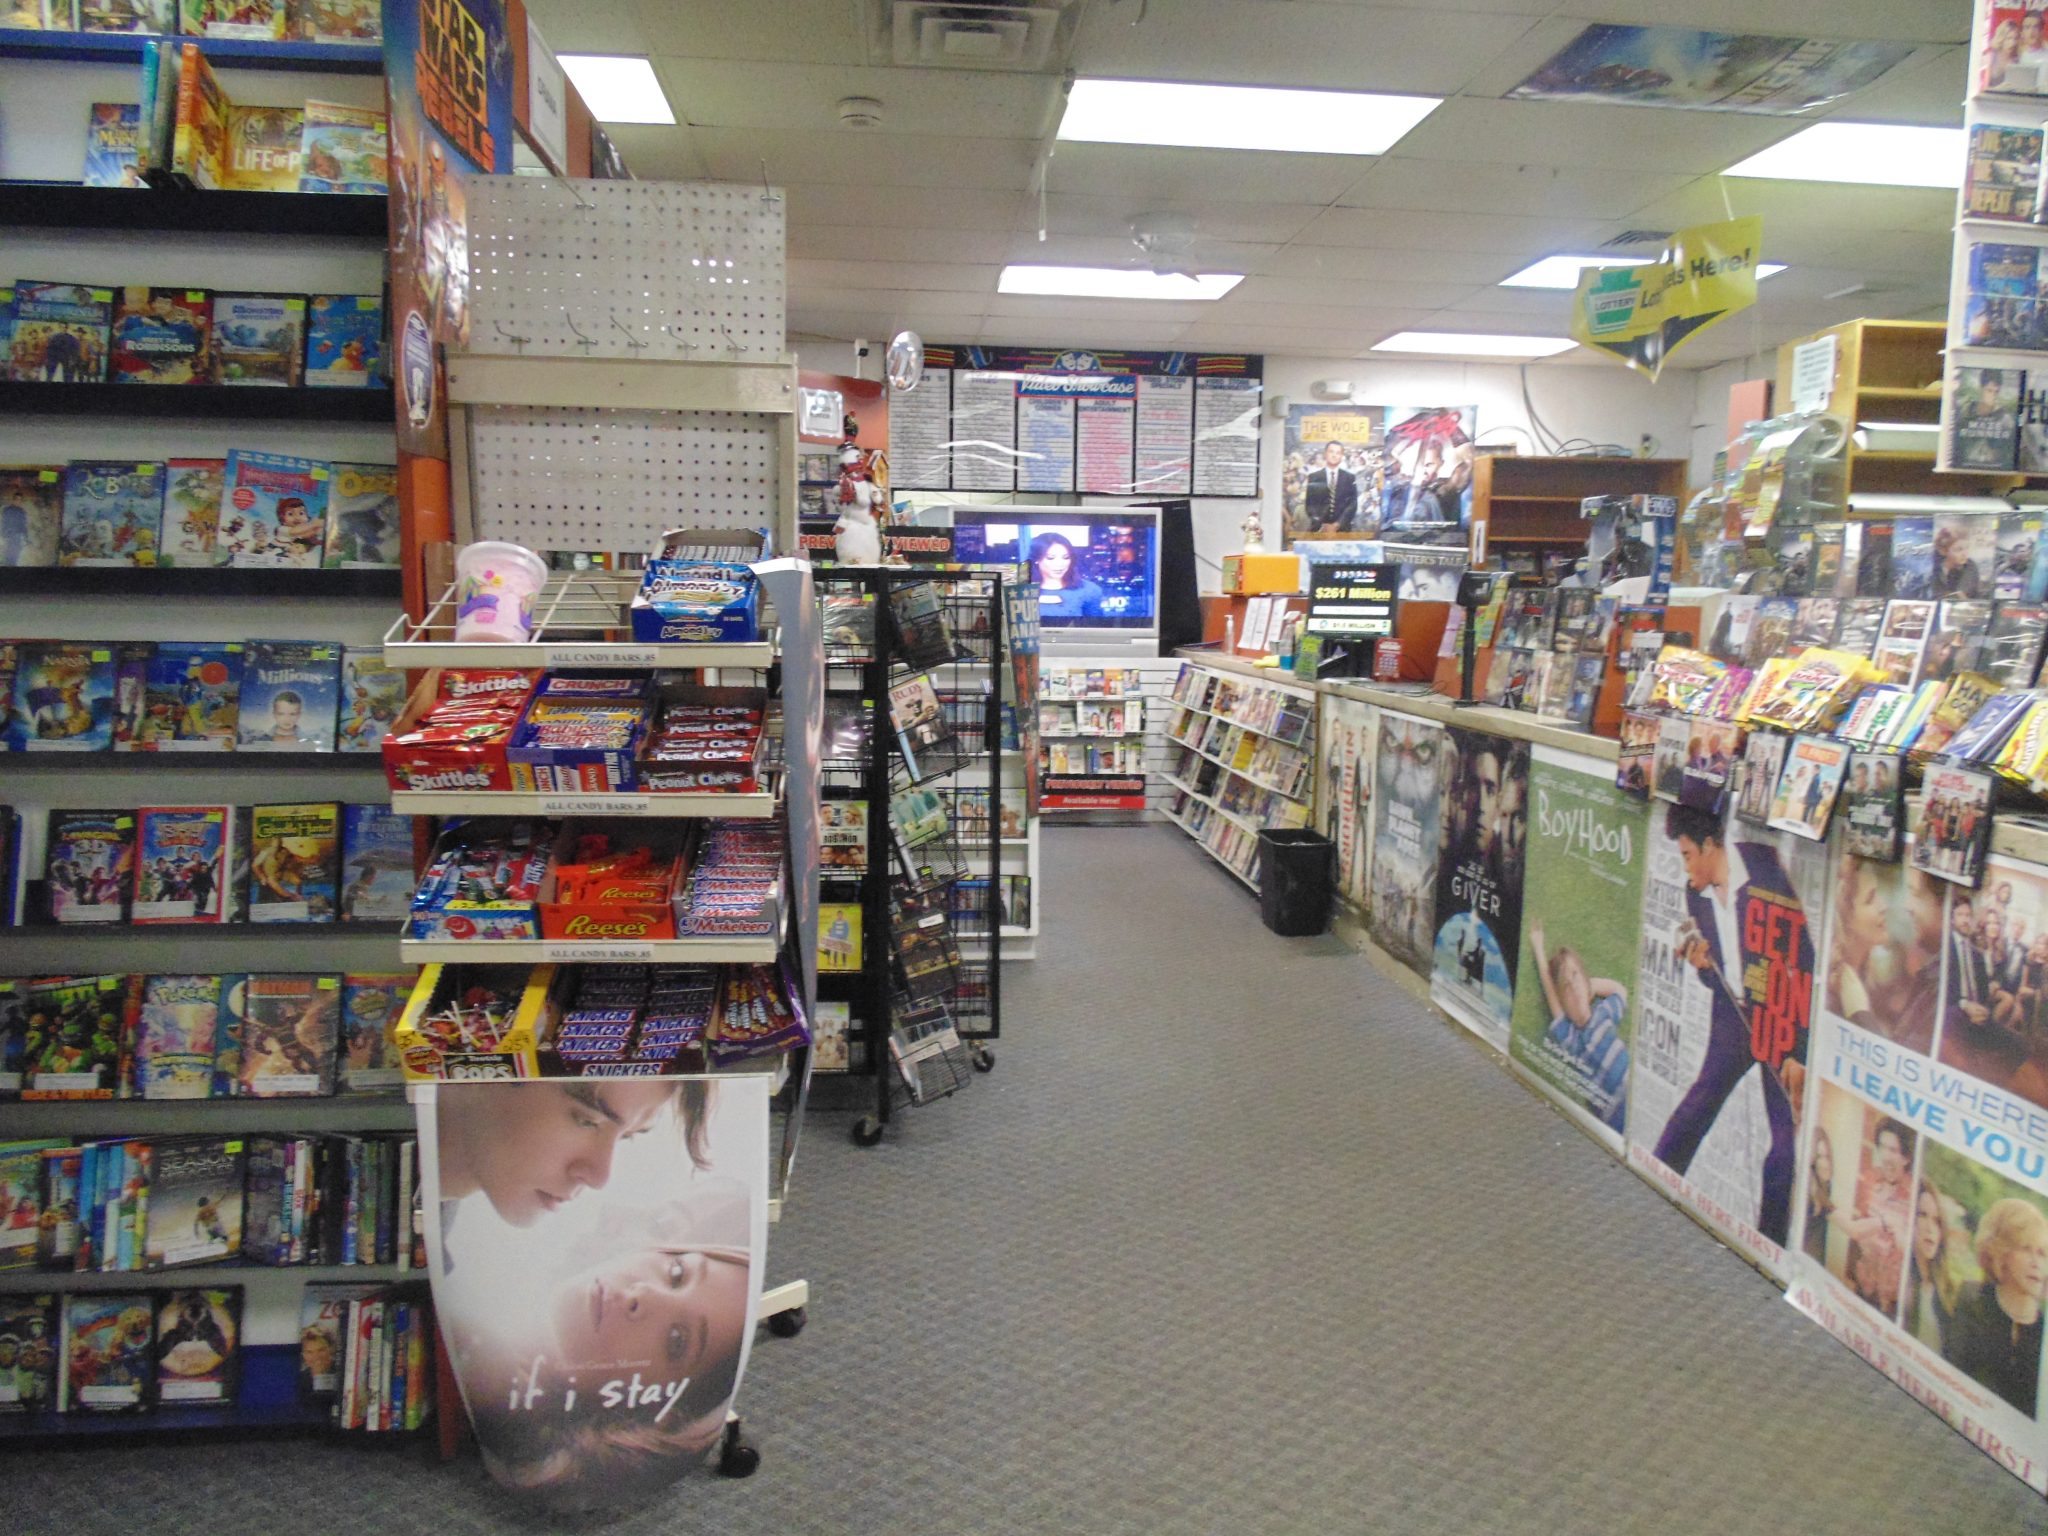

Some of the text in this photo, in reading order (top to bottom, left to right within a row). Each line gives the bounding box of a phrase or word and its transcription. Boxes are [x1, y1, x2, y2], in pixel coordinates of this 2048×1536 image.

[234, 149, 272, 171] LIFE
[289, 153, 301, 172] P
[1691, 248, 1751, 278] Here!
[1595, 297, 1635, 311] LOTTERY
[126, 340, 195, 352] ROBINSONS
[1019, 373, 1135, 395] Video Showcase
[1303, 421, 1366, 433] THE WOLF
[893, 535, 951, 552] VIEWED
[1386, 552, 1464, 566] WINTER'S TALE
[1315, 587, 1347, 599] $261
[551, 653, 570, 661] ALL
[574, 653, 609, 661] CANDY
[612, 653, 641, 661] BARS
[257, 668, 324, 685] Millions
[551, 679, 629, 691] CRUNCH
[452, 678, 531, 698] Skittles
[713, 707, 750, 716] Chews
[669, 722, 752, 734] Peanut Chews
[709, 739, 748, 748] Chews
[656, 750, 743, 761] Peanut Chews
[408, 771, 491, 791] Skittles
[648, 772, 743, 790] Peanut Chews
[1451, 876, 1500, 917] GIVER
[565, 915, 648, 936] Reese's
[694, 918, 771, 935] Musketeers
[1744, 898, 1808, 969] GET
[572, 950, 607, 958] CANDY
[610, 950, 637, 958] BARS
[1641, 936, 1684, 989] MAN
[1766, 959, 1813, 1029] ON
[565, 1010, 631, 1022] SNICKERS
[562, 1024, 628, 1036] SNICKERS
[1637, 1005, 1680, 1057] ICON
[1750, 1005, 1795, 1070] UP
[557, 1039, 624, 1052] SNICKERS
[449, 1063, 514, 1079] POPS
[585, 1064, 660, 1076] SNICKERS
[1836, 1025, 2048, 1144] THIS IS WHERE
[1833, 1055, 2045, 1179] I LEAVE YOU
[1738, 1222, 1783, 1263] FIRST
[509, 1354, 691, 1423] if i stay
[1796, 1287, 1889, 1371] AVAILABLE
[1896, 1365, 1951, 1419] HERE
[1961, 1416, 2034, 1480] FIRST
